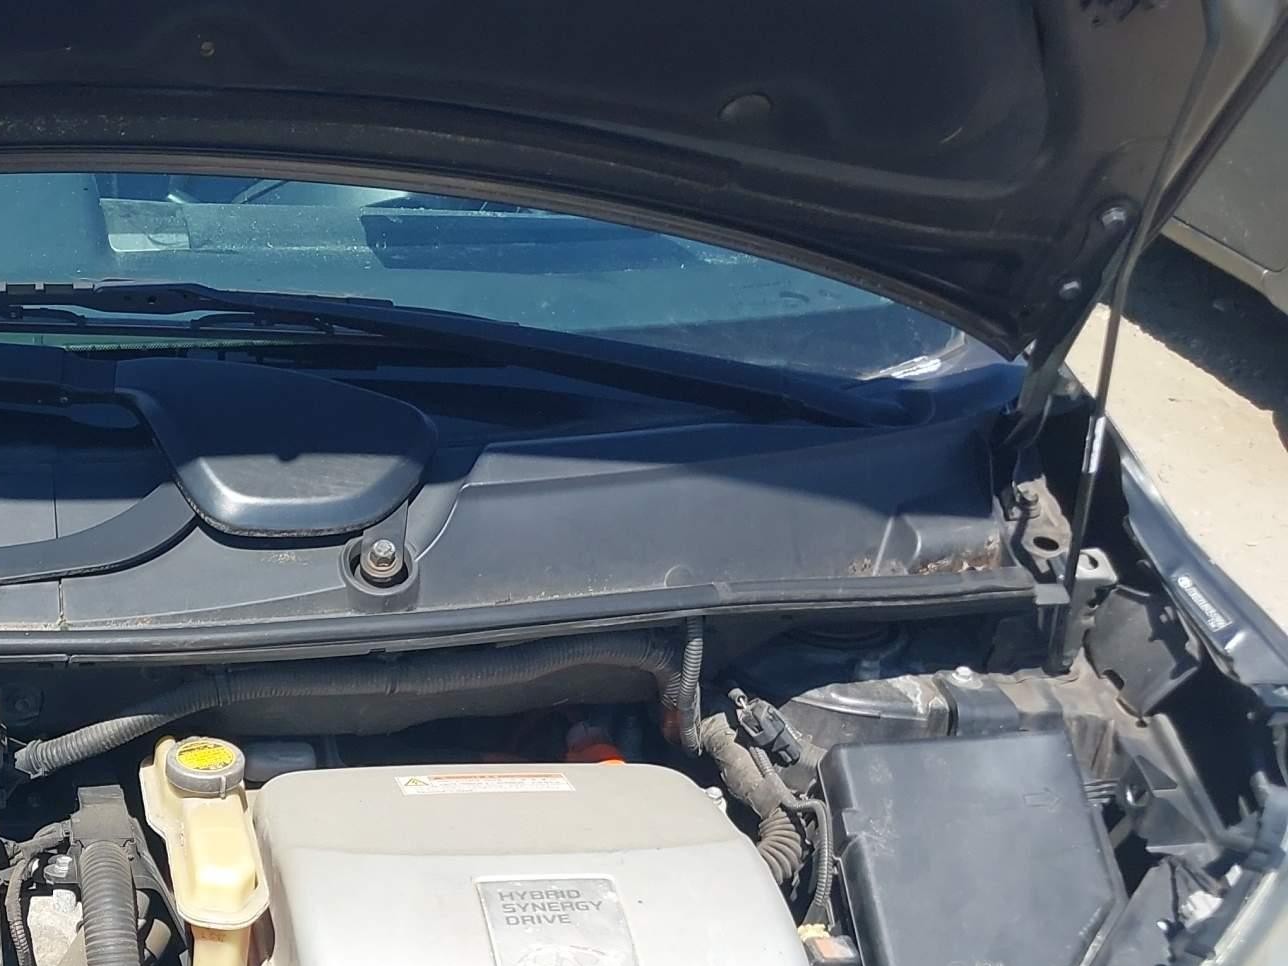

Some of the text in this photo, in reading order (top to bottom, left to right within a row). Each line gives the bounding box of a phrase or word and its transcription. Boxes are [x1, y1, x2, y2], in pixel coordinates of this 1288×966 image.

[498, 889, 581, 901] HYBRID
[502, 900, 603, 914] SYNERGY
[506, 913, 572, 926] DRIVE
